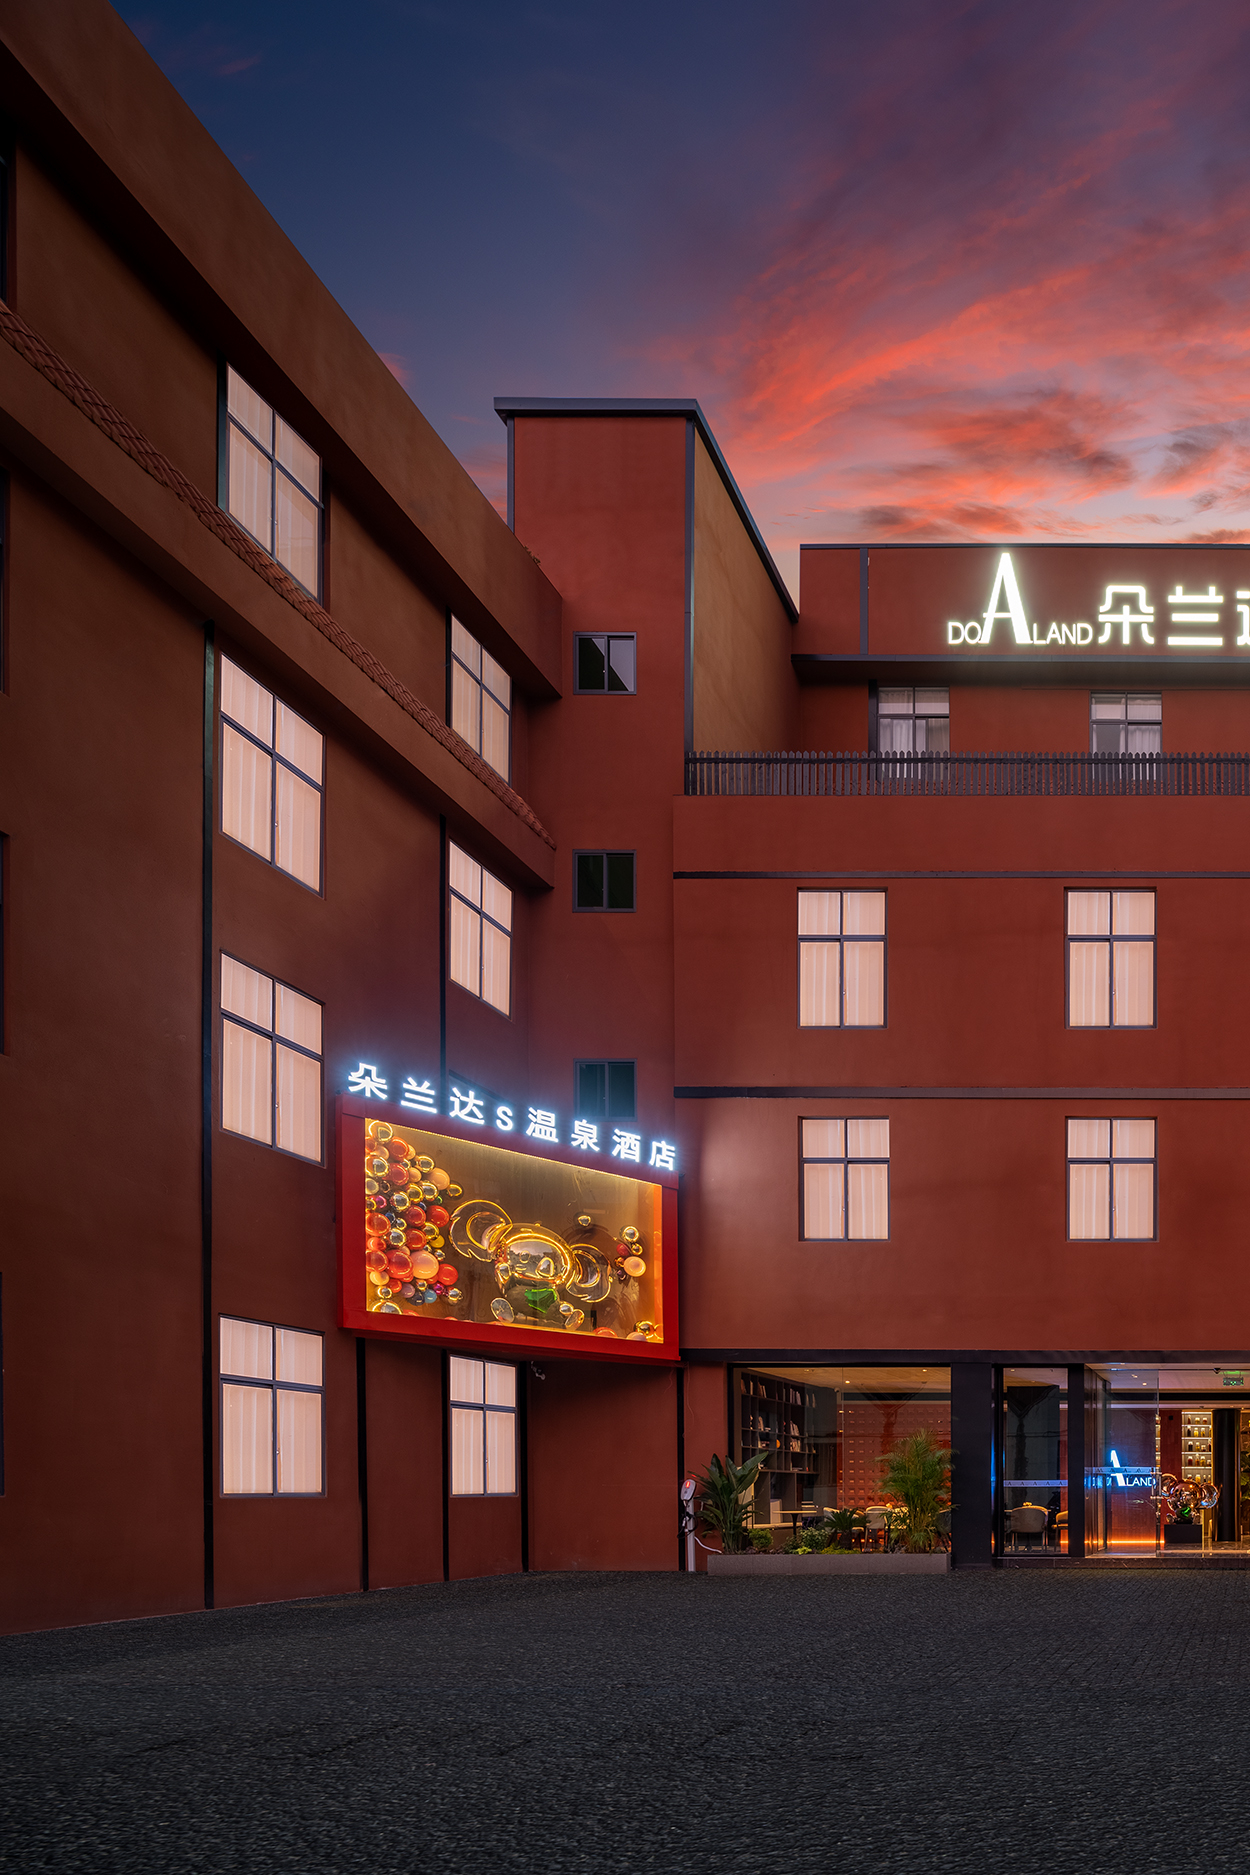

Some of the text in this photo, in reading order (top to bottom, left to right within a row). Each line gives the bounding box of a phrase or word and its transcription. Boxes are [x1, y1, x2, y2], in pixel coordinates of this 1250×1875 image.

[347, 1062, 676, 1171] 朵兰达S温泉酒店
